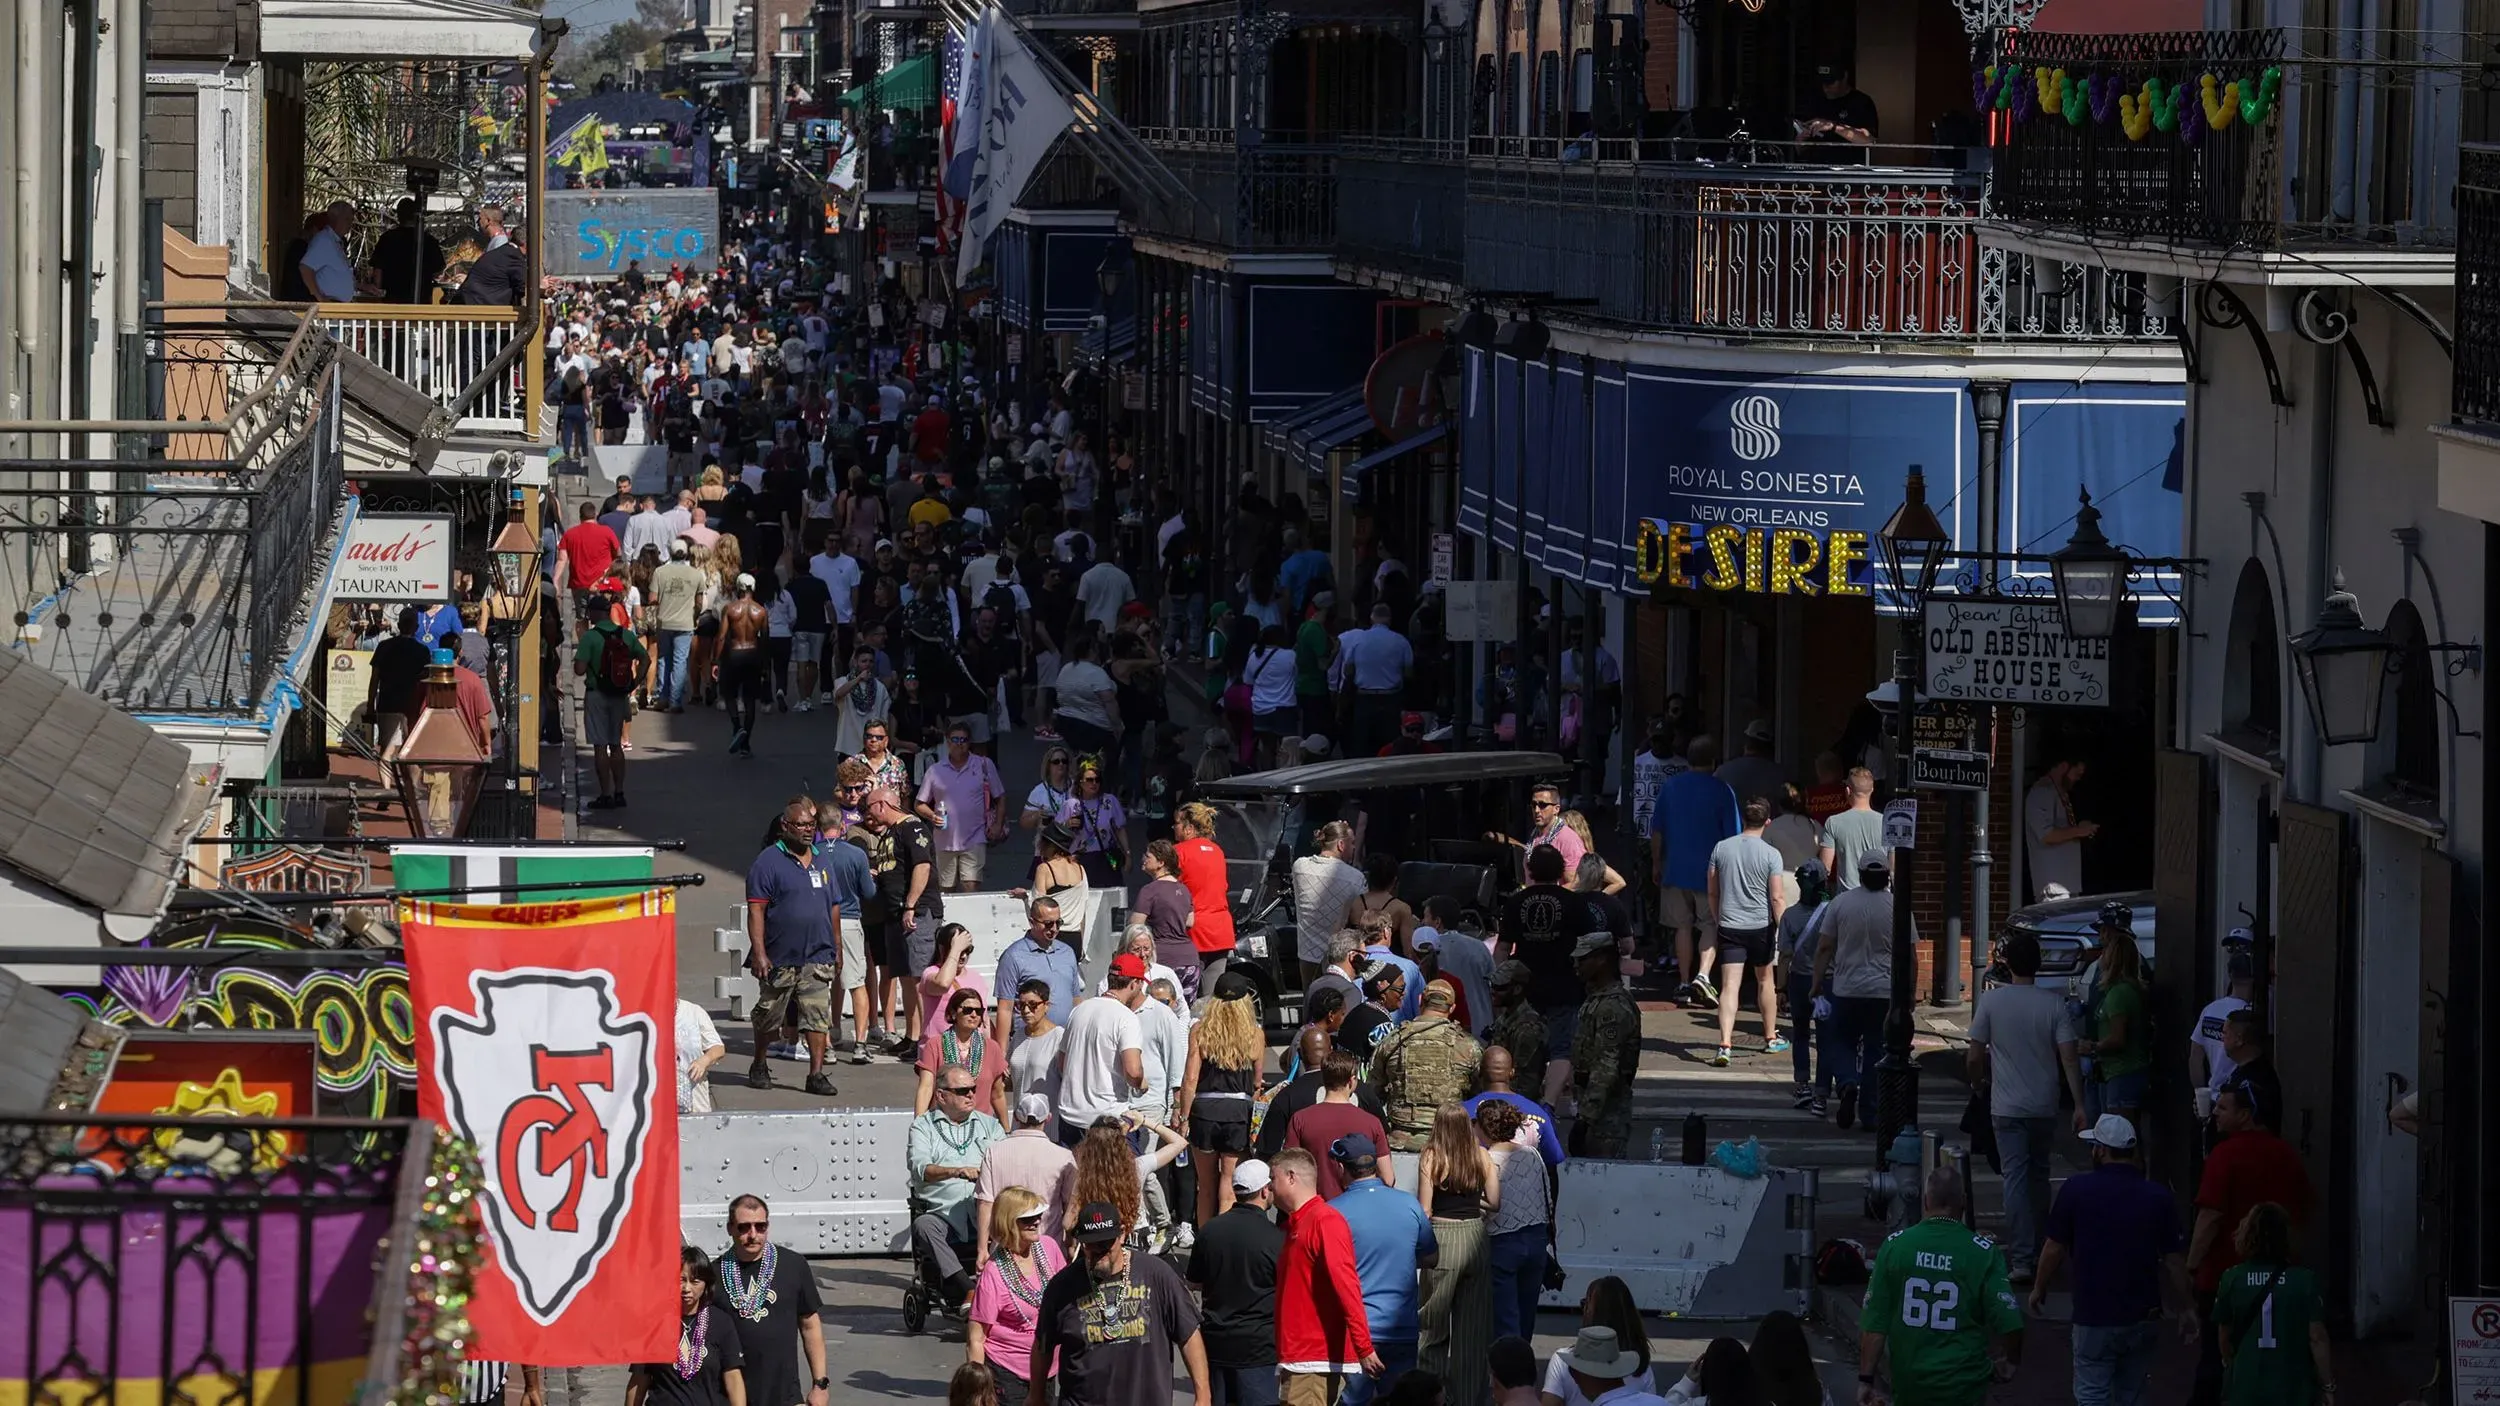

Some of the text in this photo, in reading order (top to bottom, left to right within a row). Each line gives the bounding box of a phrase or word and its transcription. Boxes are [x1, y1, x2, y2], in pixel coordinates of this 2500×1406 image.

[578, 219, 704, 270] Sysco
[866, 435, 880, 455] 7
[1669, 465, 1864, 496] ROYAL SONESTA
[1691, 504, 1829, 527] NEW ORLEANS
[358, 564, 398, 573] Since 1918
[1636, 517, 1875, 597] DESIRE
[335, 578, 422, 594] TAURANT
[2000, 606, 2062, 636] Lafitt
[1931, 627, 2107, 660] OLD ABSINTHE
[1974, 659, 2061, 687] HOUSE
[1950, 685, 2085, 702] SINCE 1807
[1944, 716, 1977, 730] BAR
[1917, 760, 1986, 784] Bourbon
[491, 902, 581, 925] CHIEFS
[1084, 1219, 1114, 1231] WAYNE
[1915, 1250, 1953, 1271] KELCE
[2247, 1271, 2287, 1287] HURS
[1902, 1275, 1960, 1331] 62
[2257, 1291, 2277, 1348] 1
[2458, 1358, 2468, 1368] TO
